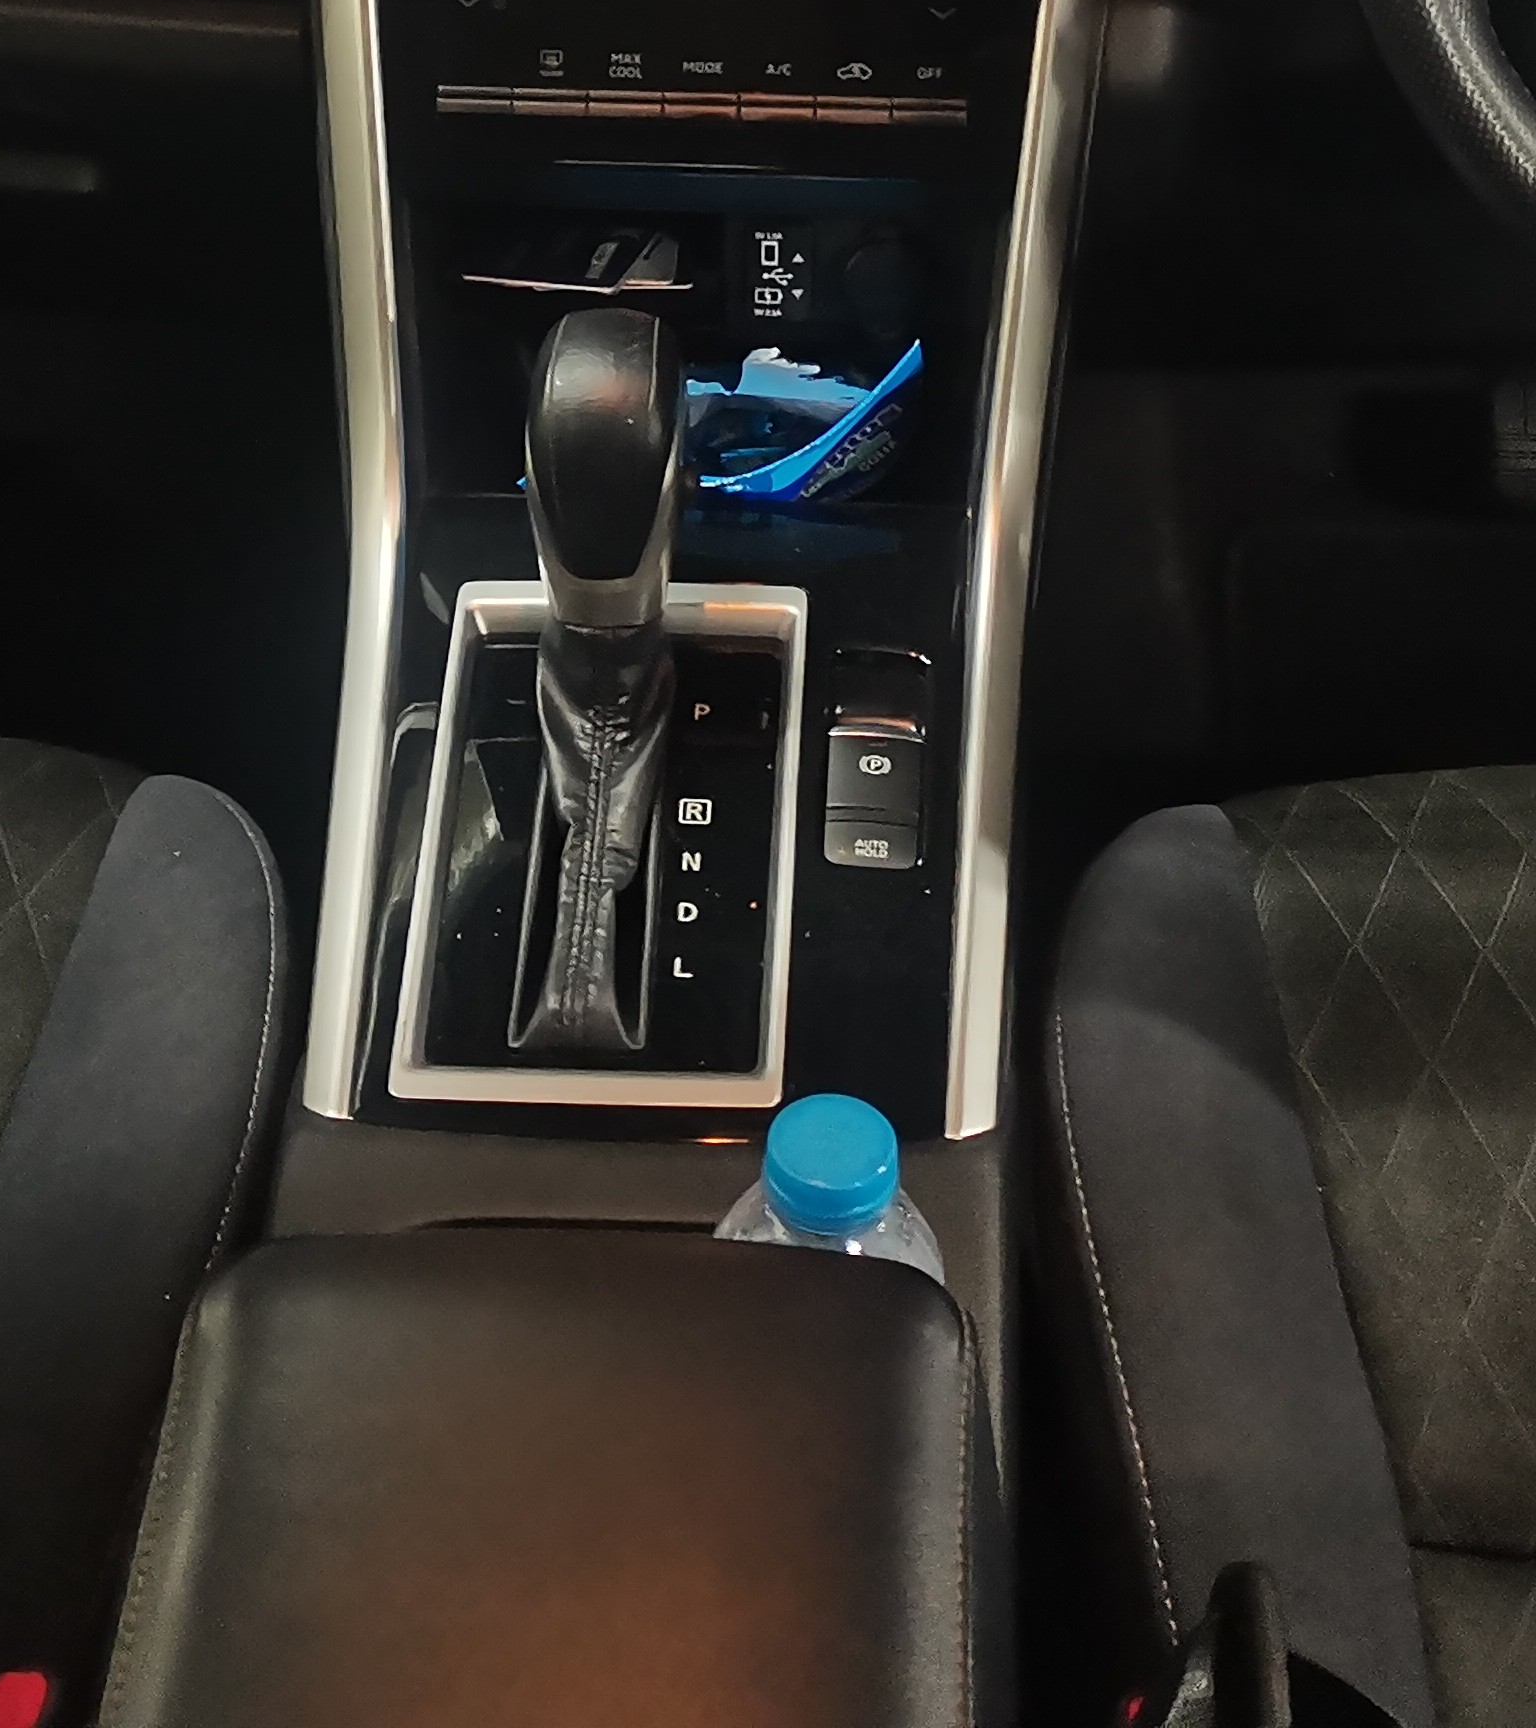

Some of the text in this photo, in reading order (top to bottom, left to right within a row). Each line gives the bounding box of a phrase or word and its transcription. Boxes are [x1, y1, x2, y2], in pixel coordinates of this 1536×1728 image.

[611, 53, 642, 65] MAX
[609, 66, 643, 79] COOL
[694, 703, 711, 721] P
[854, 839, 889, 850] AUTO
[681, 851, 702, 872] N
[677, 902, 699, 922] D
[673, 956, 694, 978] L
